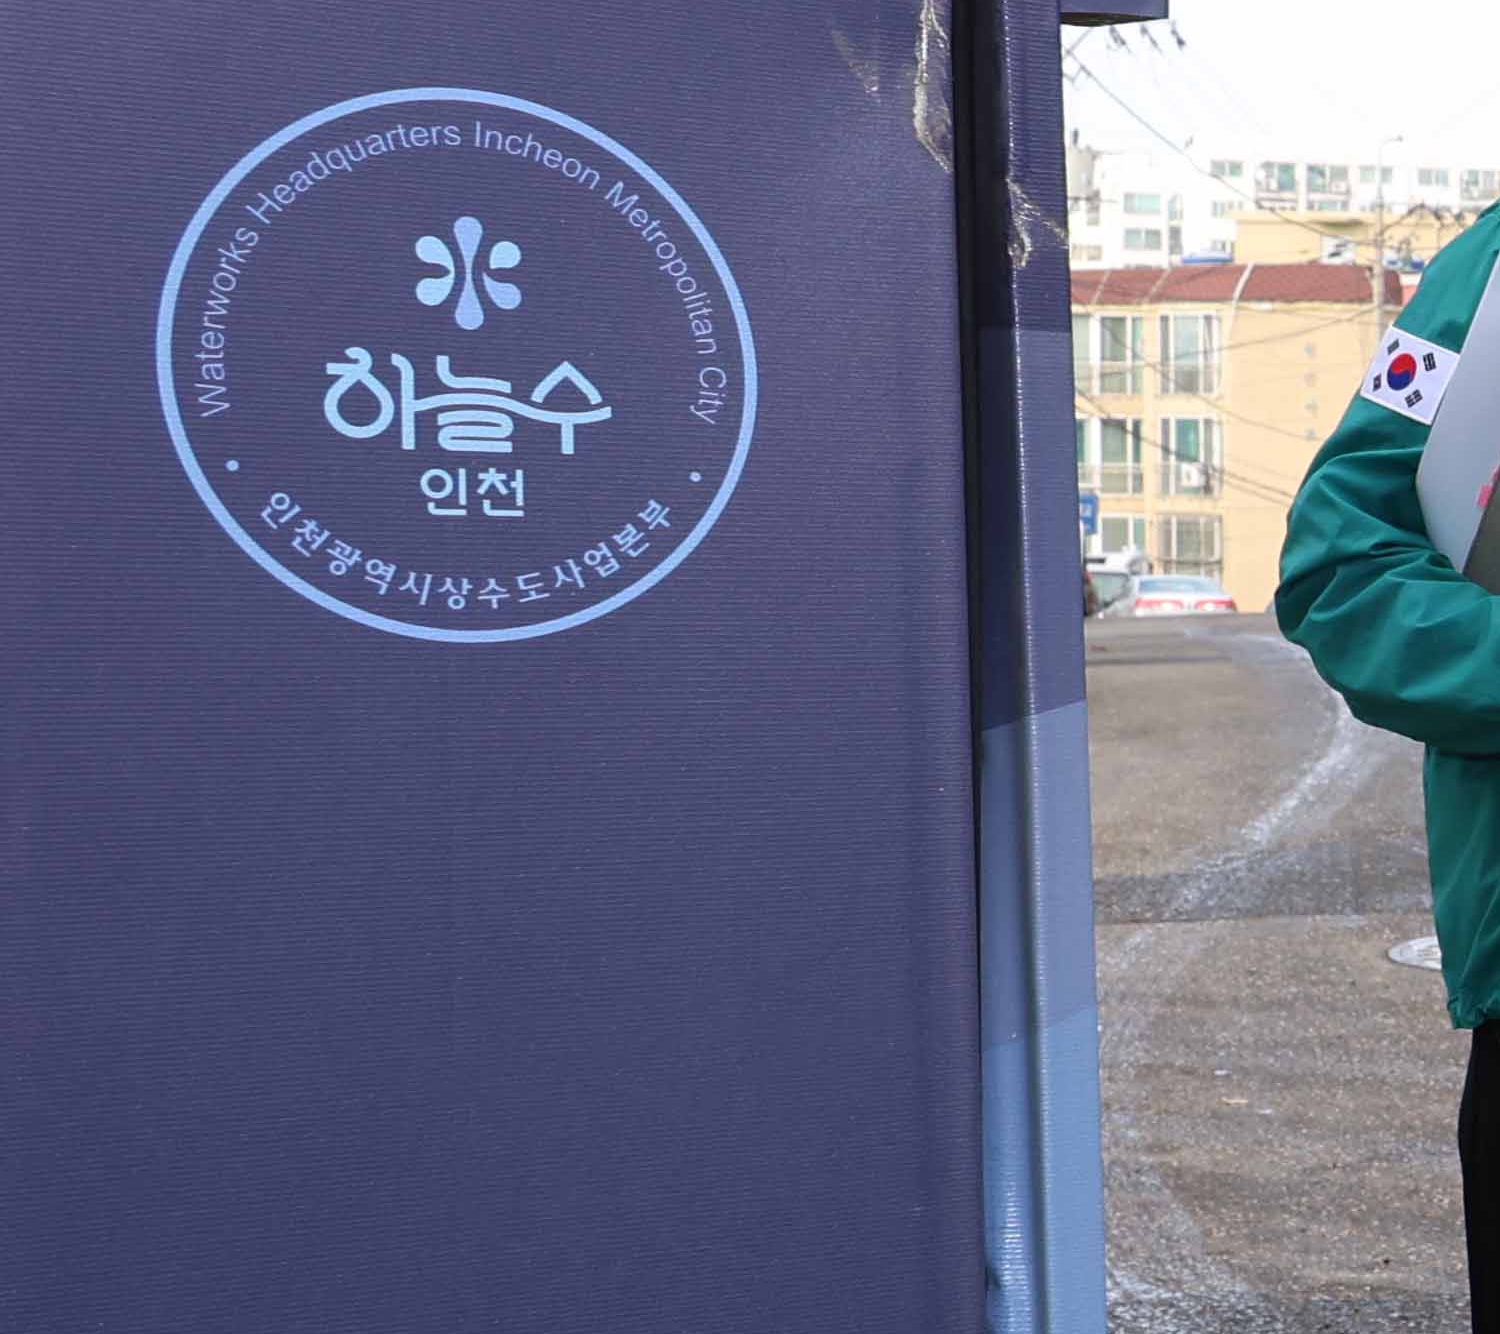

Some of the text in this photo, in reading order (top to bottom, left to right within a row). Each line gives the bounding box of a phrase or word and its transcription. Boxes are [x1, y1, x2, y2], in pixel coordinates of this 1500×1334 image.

[198, 120, 727, 425] Waterworks Headquarters Incheon Metropolitan City
[323, 346, 612, 455] 하늘수
[420, 467, 524, 516] 인천
[261, 491, 673, 610] 인천광역시상수도사업본부
